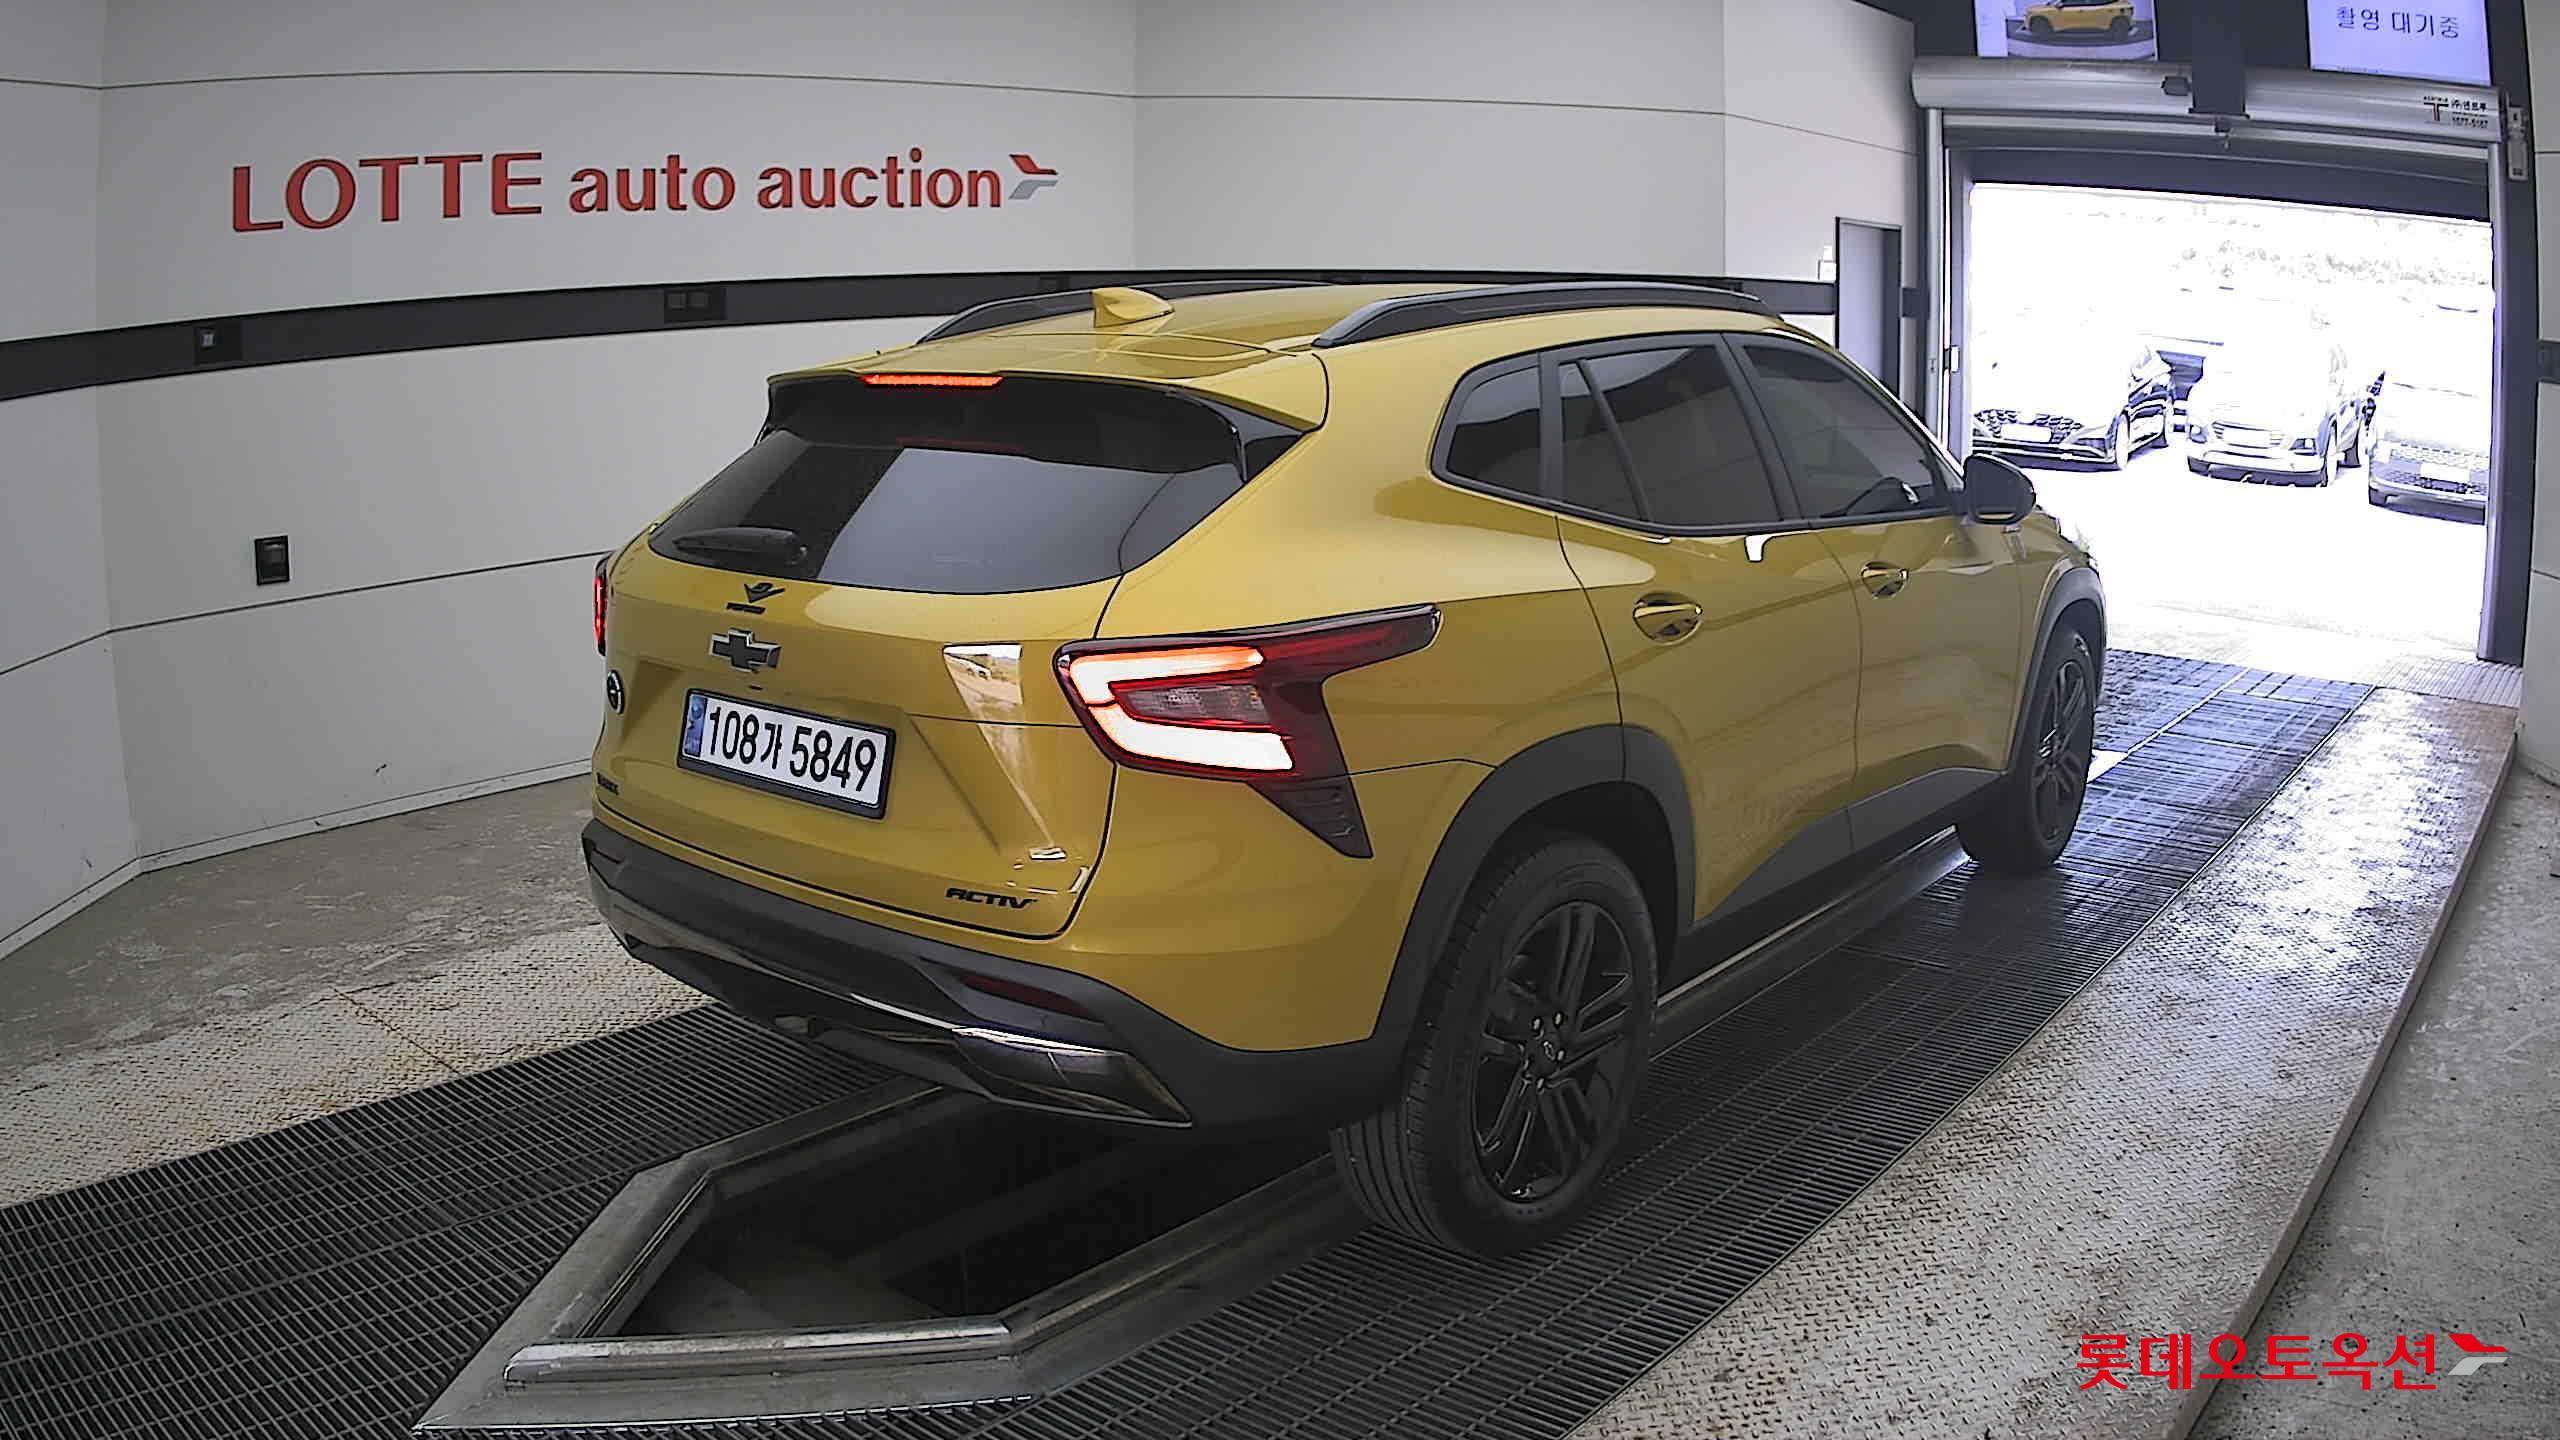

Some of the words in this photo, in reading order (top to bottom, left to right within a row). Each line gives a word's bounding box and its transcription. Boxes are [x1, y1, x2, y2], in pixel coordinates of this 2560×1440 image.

[2336, 7, 2380, 31] 촬영
[2391, 11, 2459, 39] 대기중
[232, 151, 543, 233] LOTTE
[568, 153, 737, 214] auto
[756, 146, 1001, 210] auction
[709, 706, 783, 770] 108가
[789, 725, 877, 792] 5849
[945, 887, 1038, 910] ACTIV
